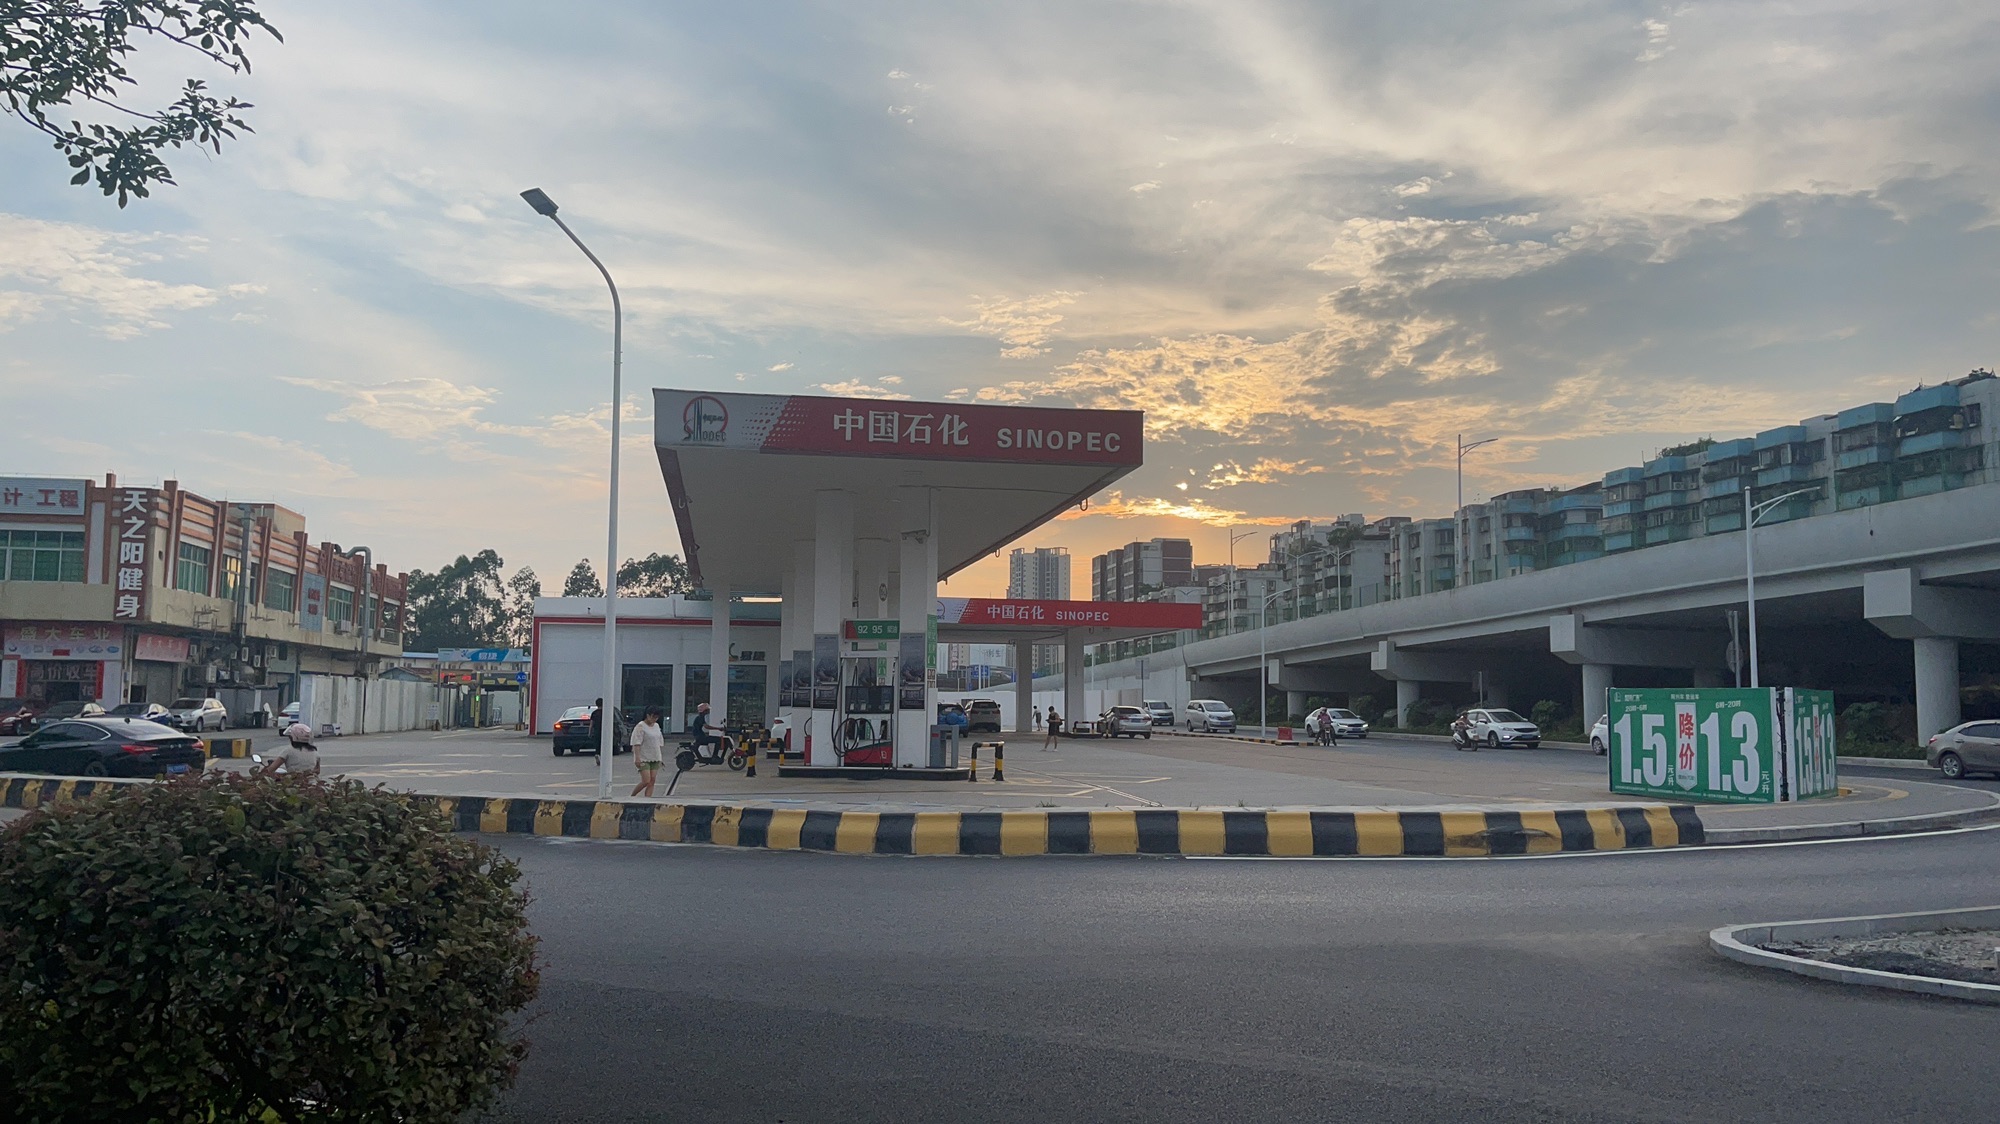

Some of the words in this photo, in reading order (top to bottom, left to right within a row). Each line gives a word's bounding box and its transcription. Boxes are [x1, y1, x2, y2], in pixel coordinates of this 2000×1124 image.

[833, 408, 969, 445] 中国石化
[996, 428, 1121, 452] SINOPEC
[115, 490, 148, 618] 天之阳健身
[987, 604, 1045, 620] 中国石化
[1055, 611, 1110, 622] SINOPEC
[20, 626, 111, 641] 盛大车业
[857, 625, 868, 634] 92
[872, 625, 883, 634] 95
[1614, 713, 1668, 787] 1.5
[1679, 713, 1694, 771] 降价
[1700, 711, 1760, 795] 1.3
[1761, 770, 1771, 794] 元/升
